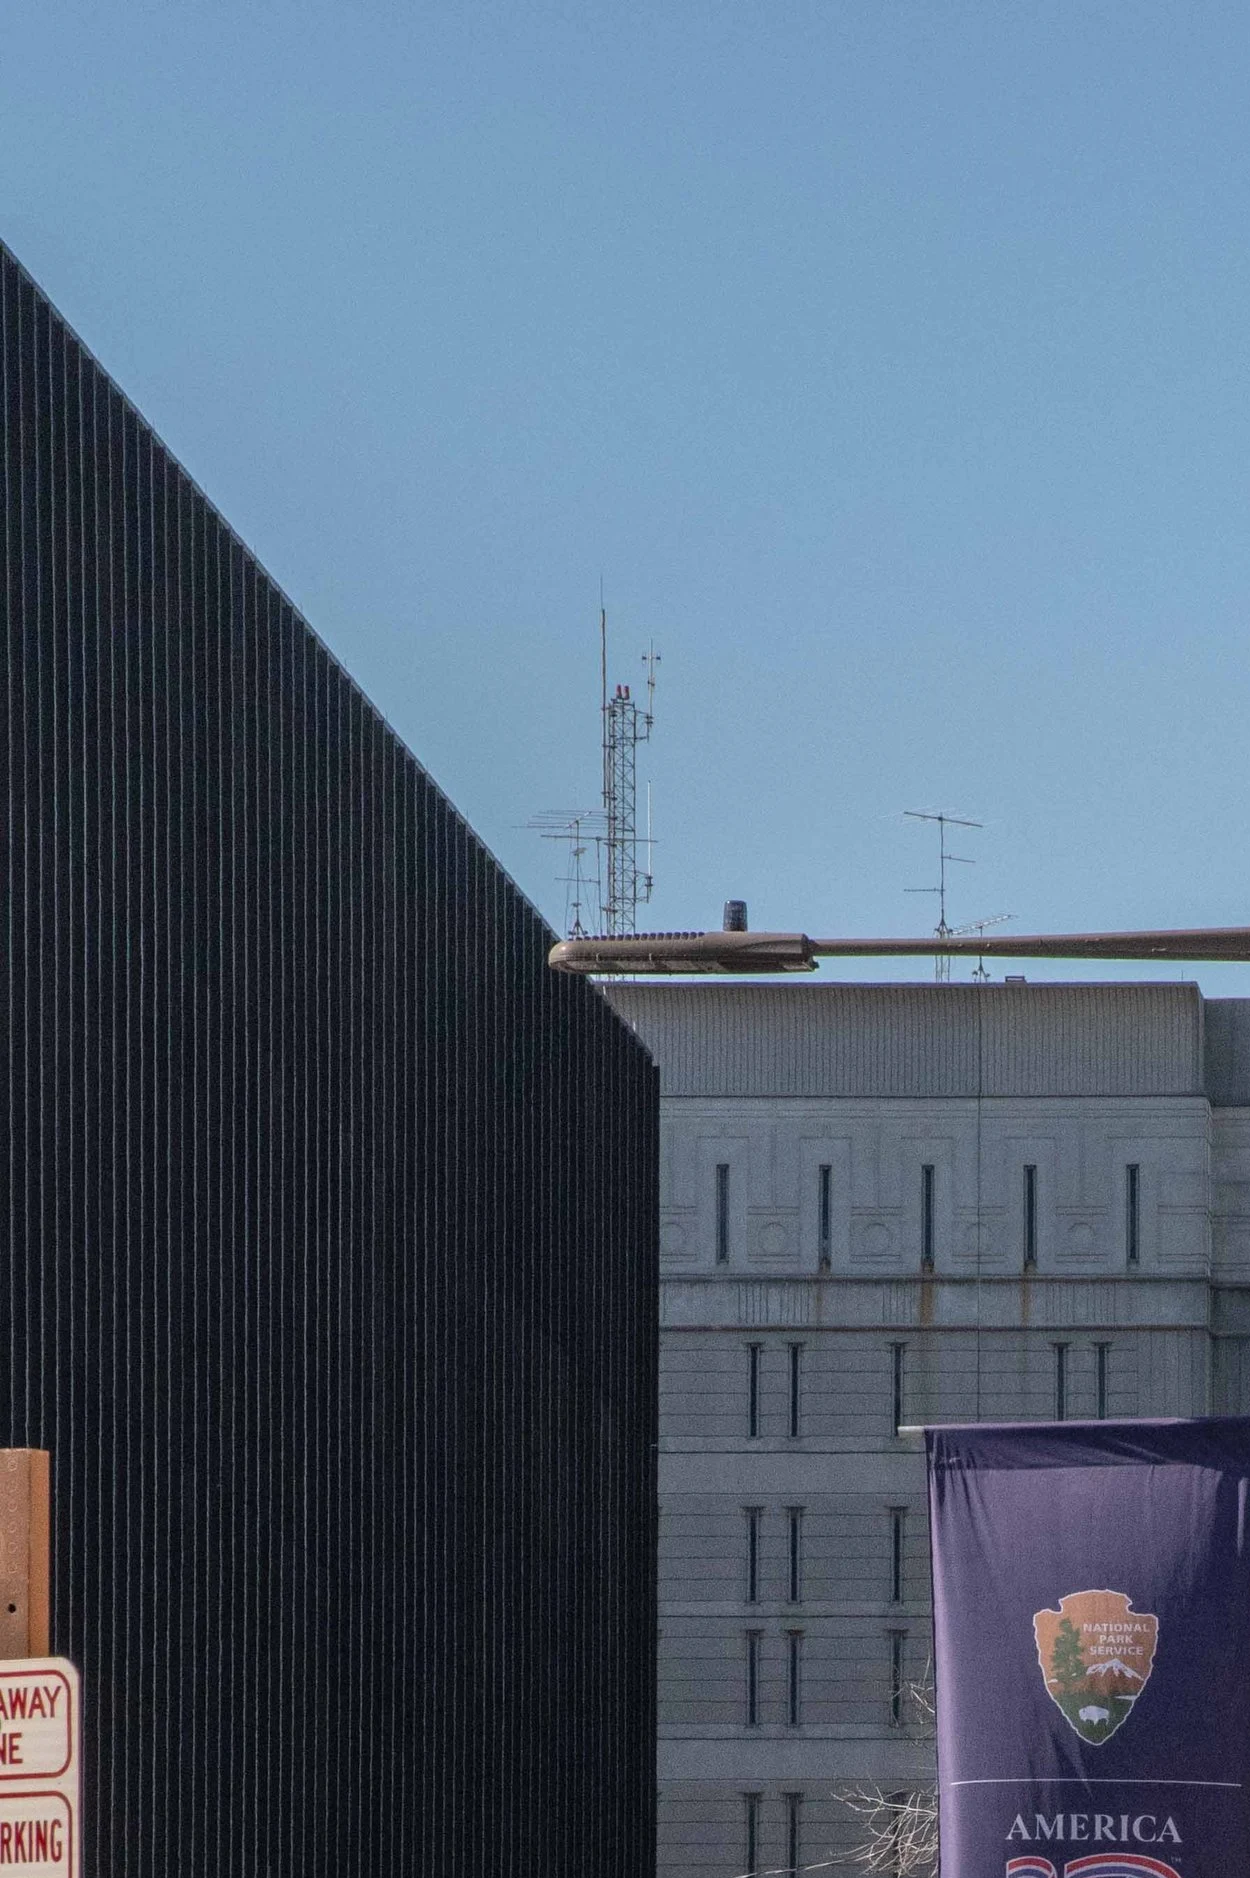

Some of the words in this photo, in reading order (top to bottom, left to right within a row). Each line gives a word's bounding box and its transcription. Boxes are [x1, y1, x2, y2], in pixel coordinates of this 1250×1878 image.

[1083, 1623, 1150, 1633] NATIONAL
[1100, 1634, 1133, 1644] PARK
[1089, 1646, 1144, 1656] SERVICE
[1005, 1813, 1182, 1843] AMERICA
